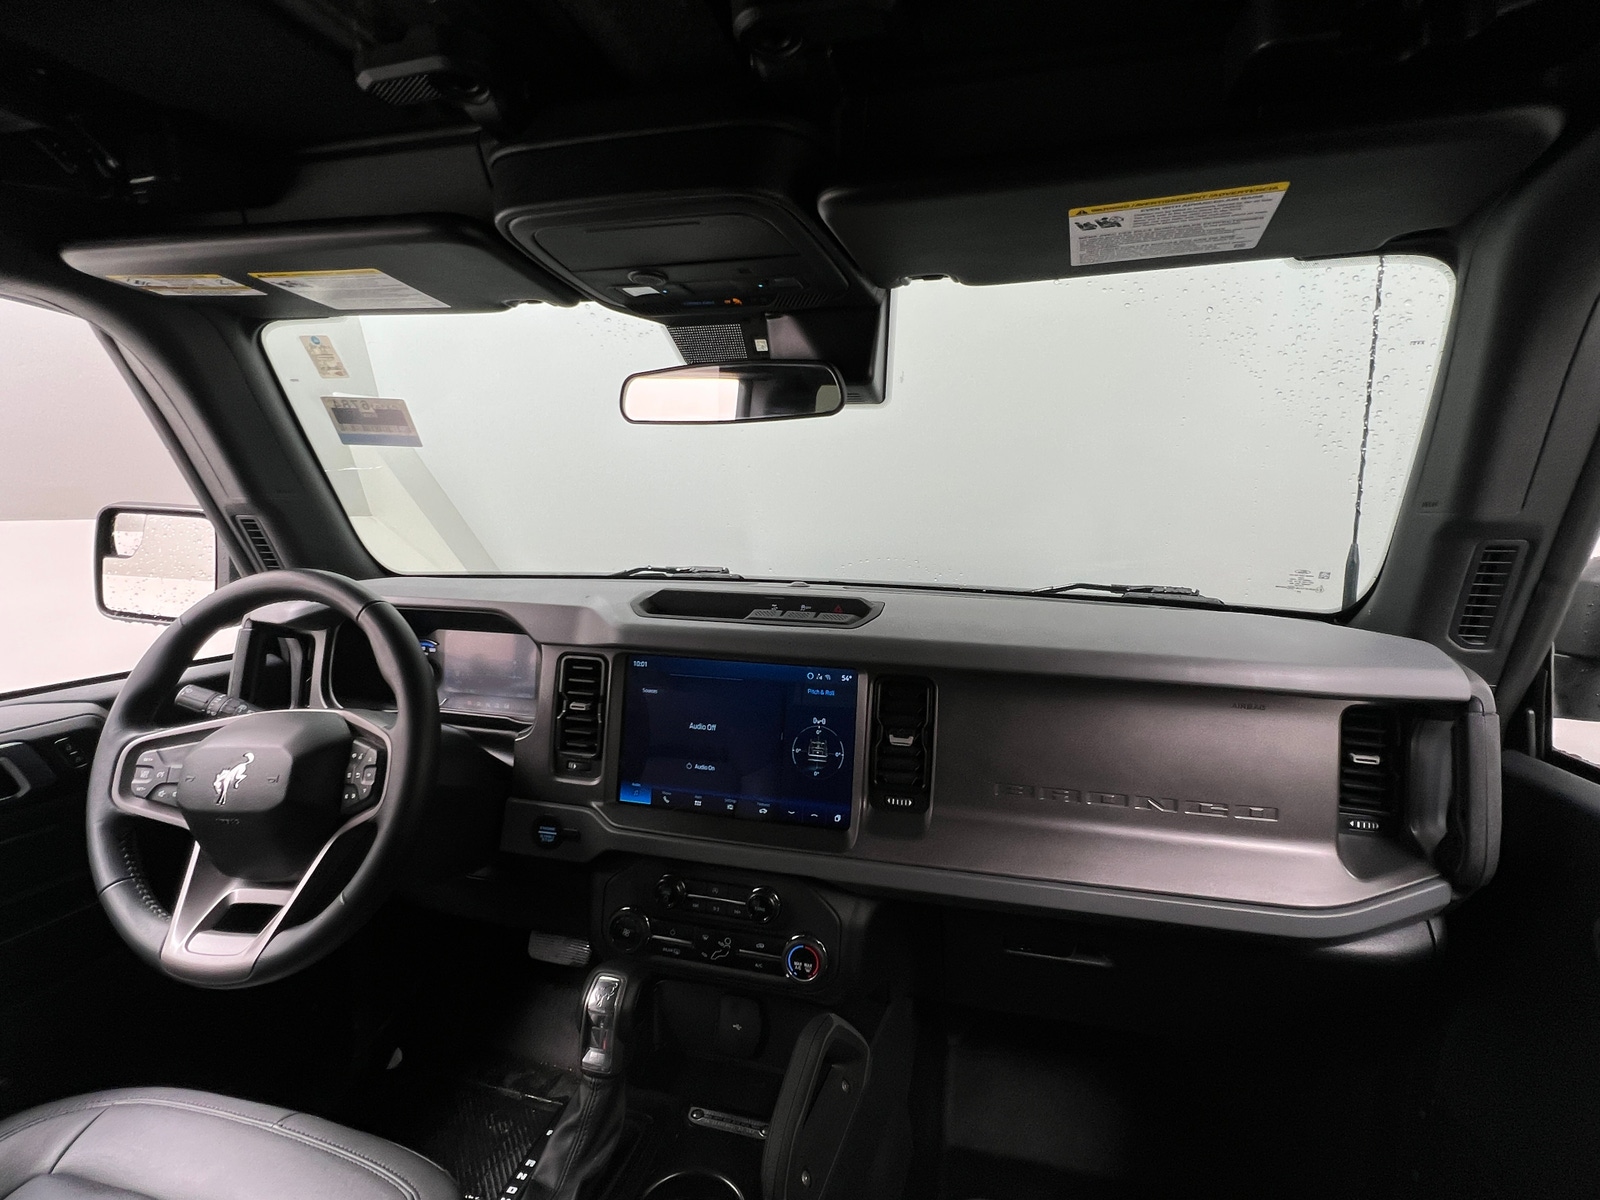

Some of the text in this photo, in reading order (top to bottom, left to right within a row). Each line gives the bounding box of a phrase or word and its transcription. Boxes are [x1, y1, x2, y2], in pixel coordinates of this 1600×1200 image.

[689, 722, 717, 731] Audio Off
[694, 763, 707, 771] Audio
[994, 783, 1280, 822] BRONCO
[516, 1172, 528, 1180] N
[505, 1186, 518, 1194] D
